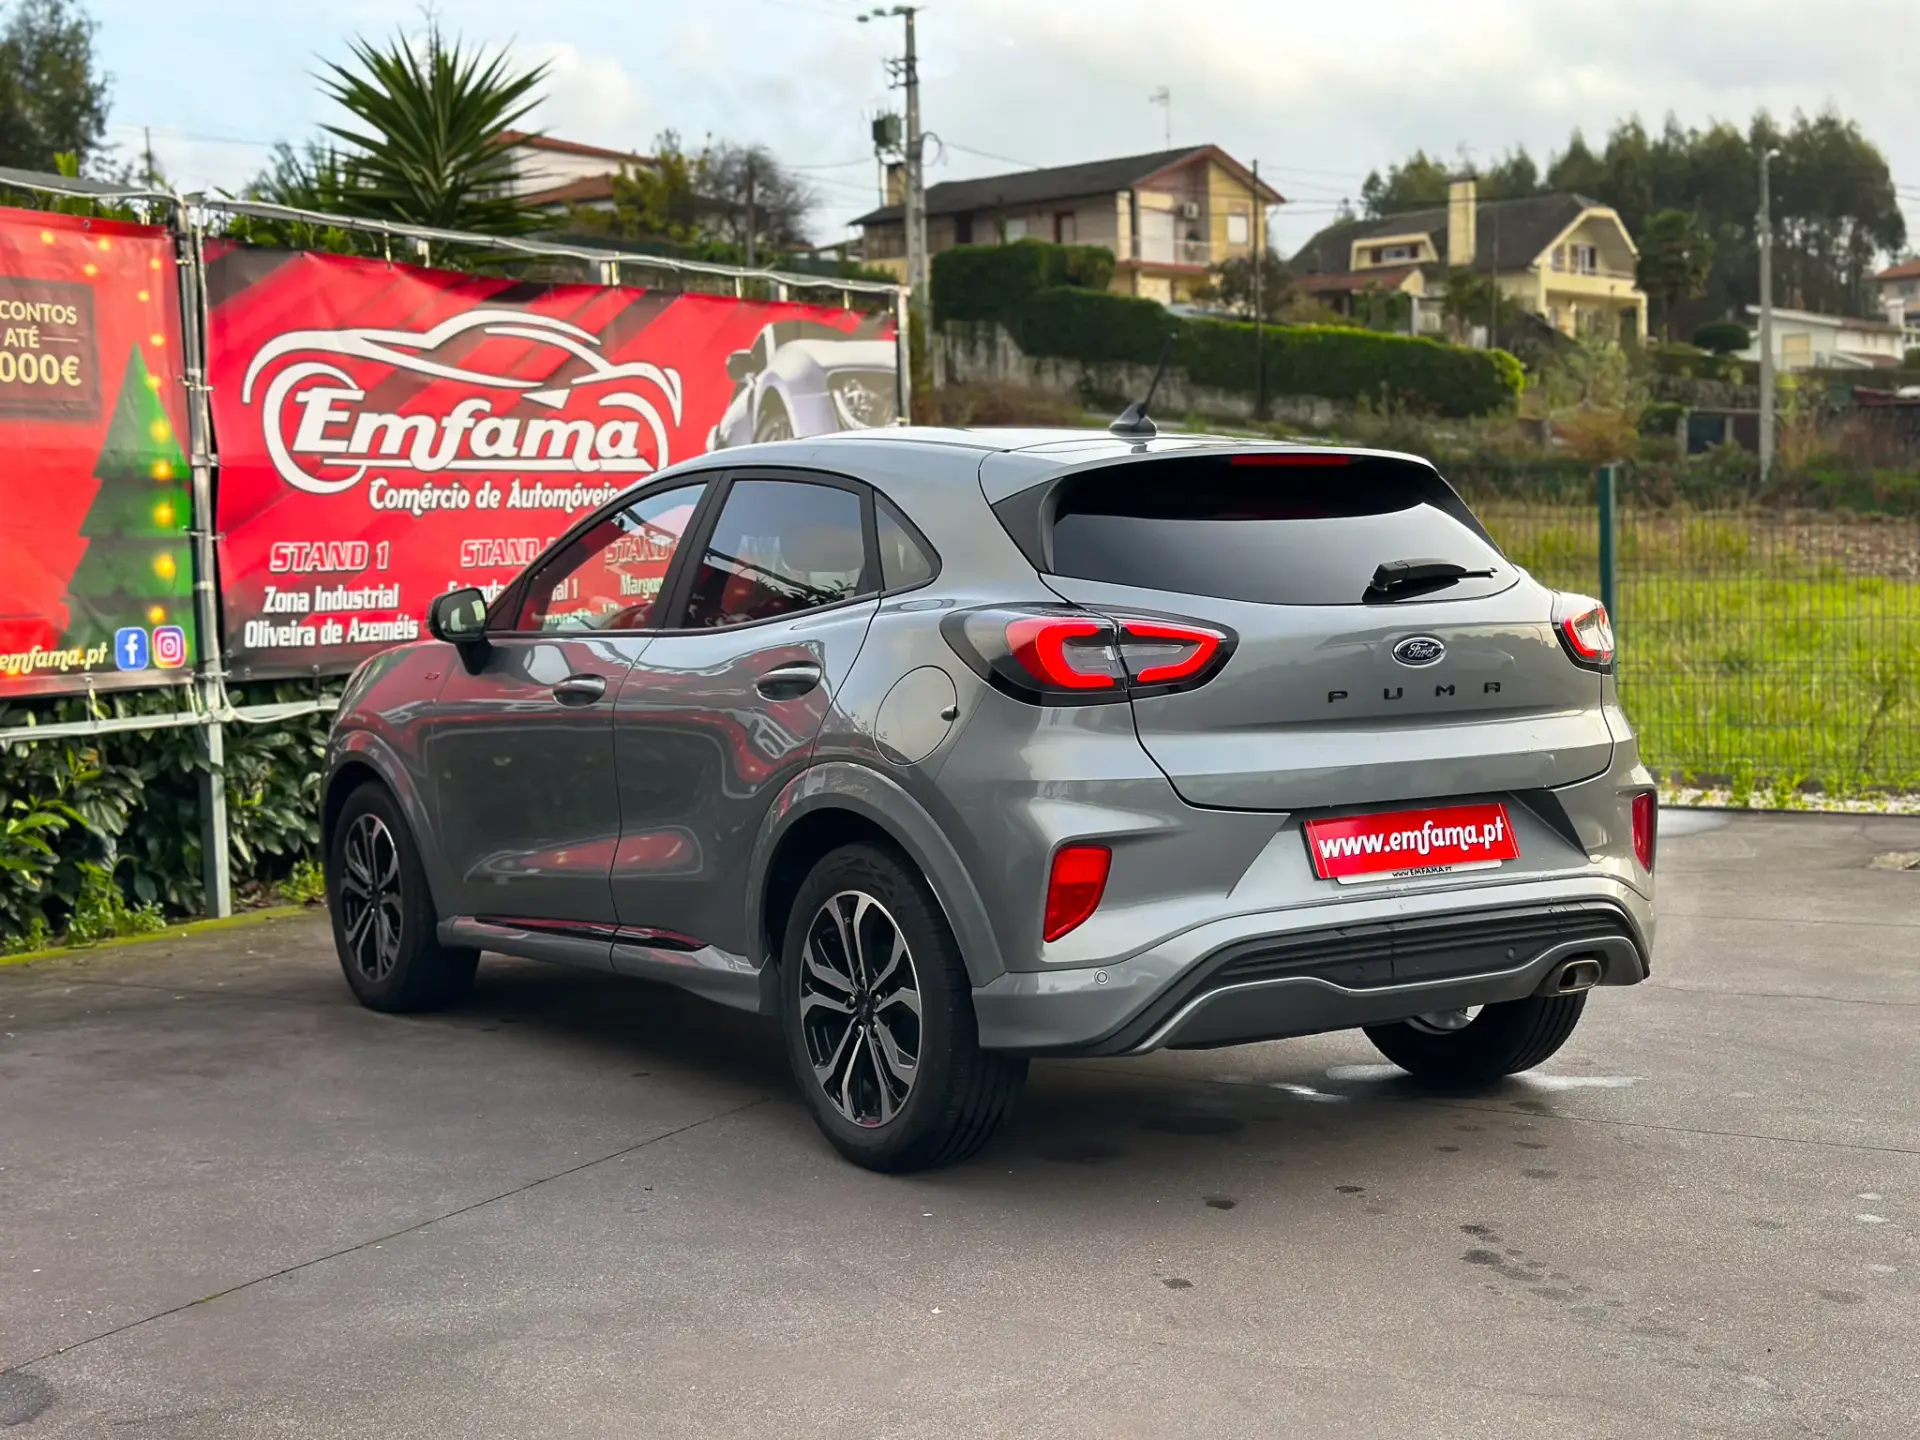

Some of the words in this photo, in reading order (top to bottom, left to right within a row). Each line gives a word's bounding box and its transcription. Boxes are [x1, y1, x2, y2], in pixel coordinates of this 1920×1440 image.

[0, 300, 77, 325] CONTOS
[4, 325, 40, 349] ATÉ
[0, 351, 82, 387] 000€
[293, 387, 640, 472] Emfama
[369, 477, 470, 516] Comércio
[475, 480, 502, 509] de
[270, 541, 369, 572] STAND
[377, 541, 390, 570] 1
[461, 538, 540, 568] STAND
[604, 536, 671, 564] STAND
[263, 586, 310, 613] Zona
[314, 583, 400, 612] Industrial
[244, 619, 316, 648] Oliveira
[320, 618, 343, 645] de
[347, 615, 419, 643] Azeméis
[0, 642, 108, 674] emfama.pt
[1407, 642, 1436, 658] Ford
[1328, 682, 1501, 703] PUMA
[1319, 816, 1504, 856] www.emfama.pt
